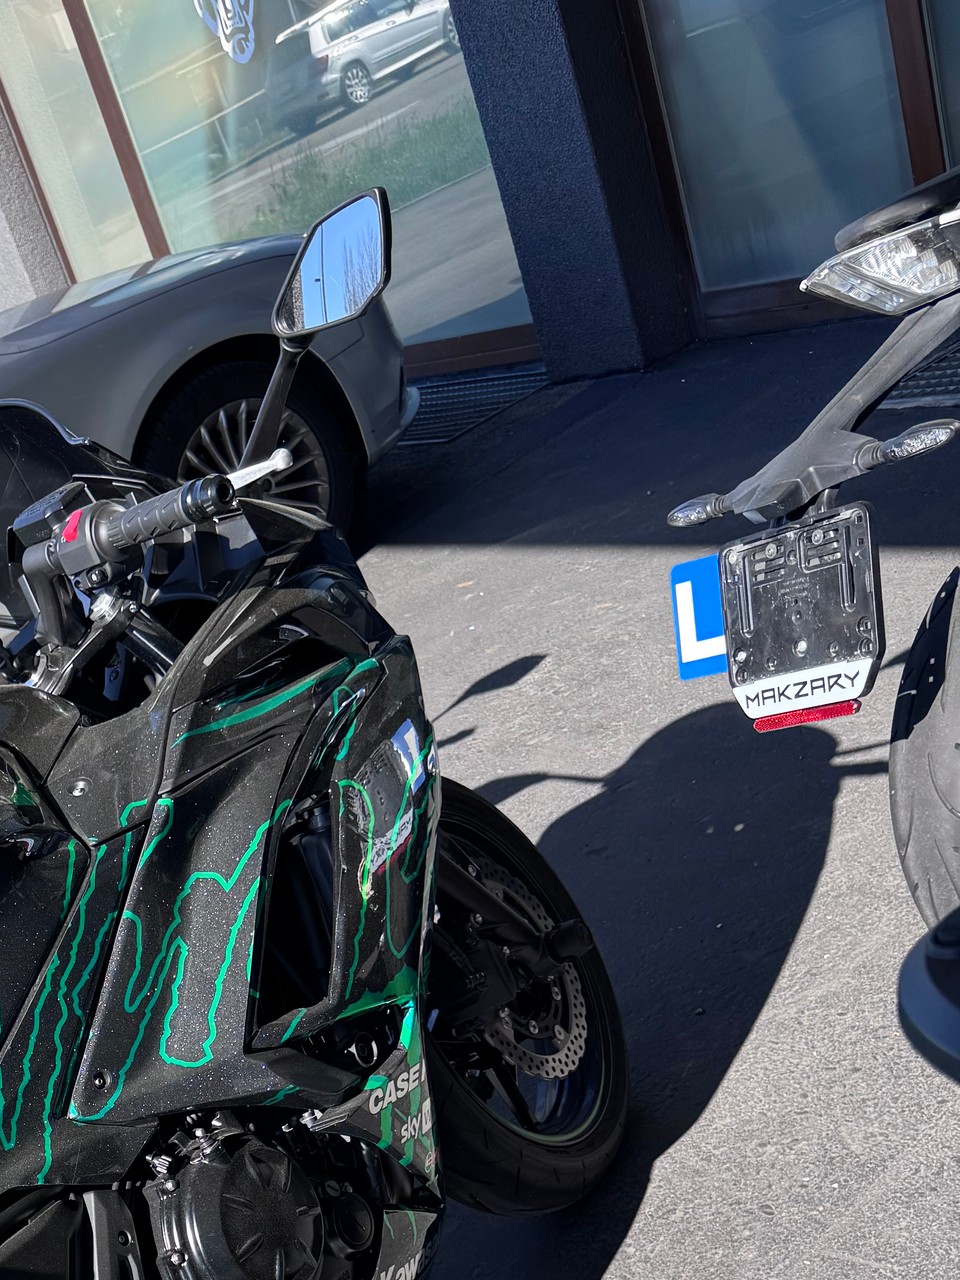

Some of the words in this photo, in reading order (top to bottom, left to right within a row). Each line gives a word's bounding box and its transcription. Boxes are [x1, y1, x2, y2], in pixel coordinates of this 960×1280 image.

[745, 671, 860, 709] MAKZARY
[368, 1063, 421, 1115] CASE
[400, 1113, 422, 1144] sky
